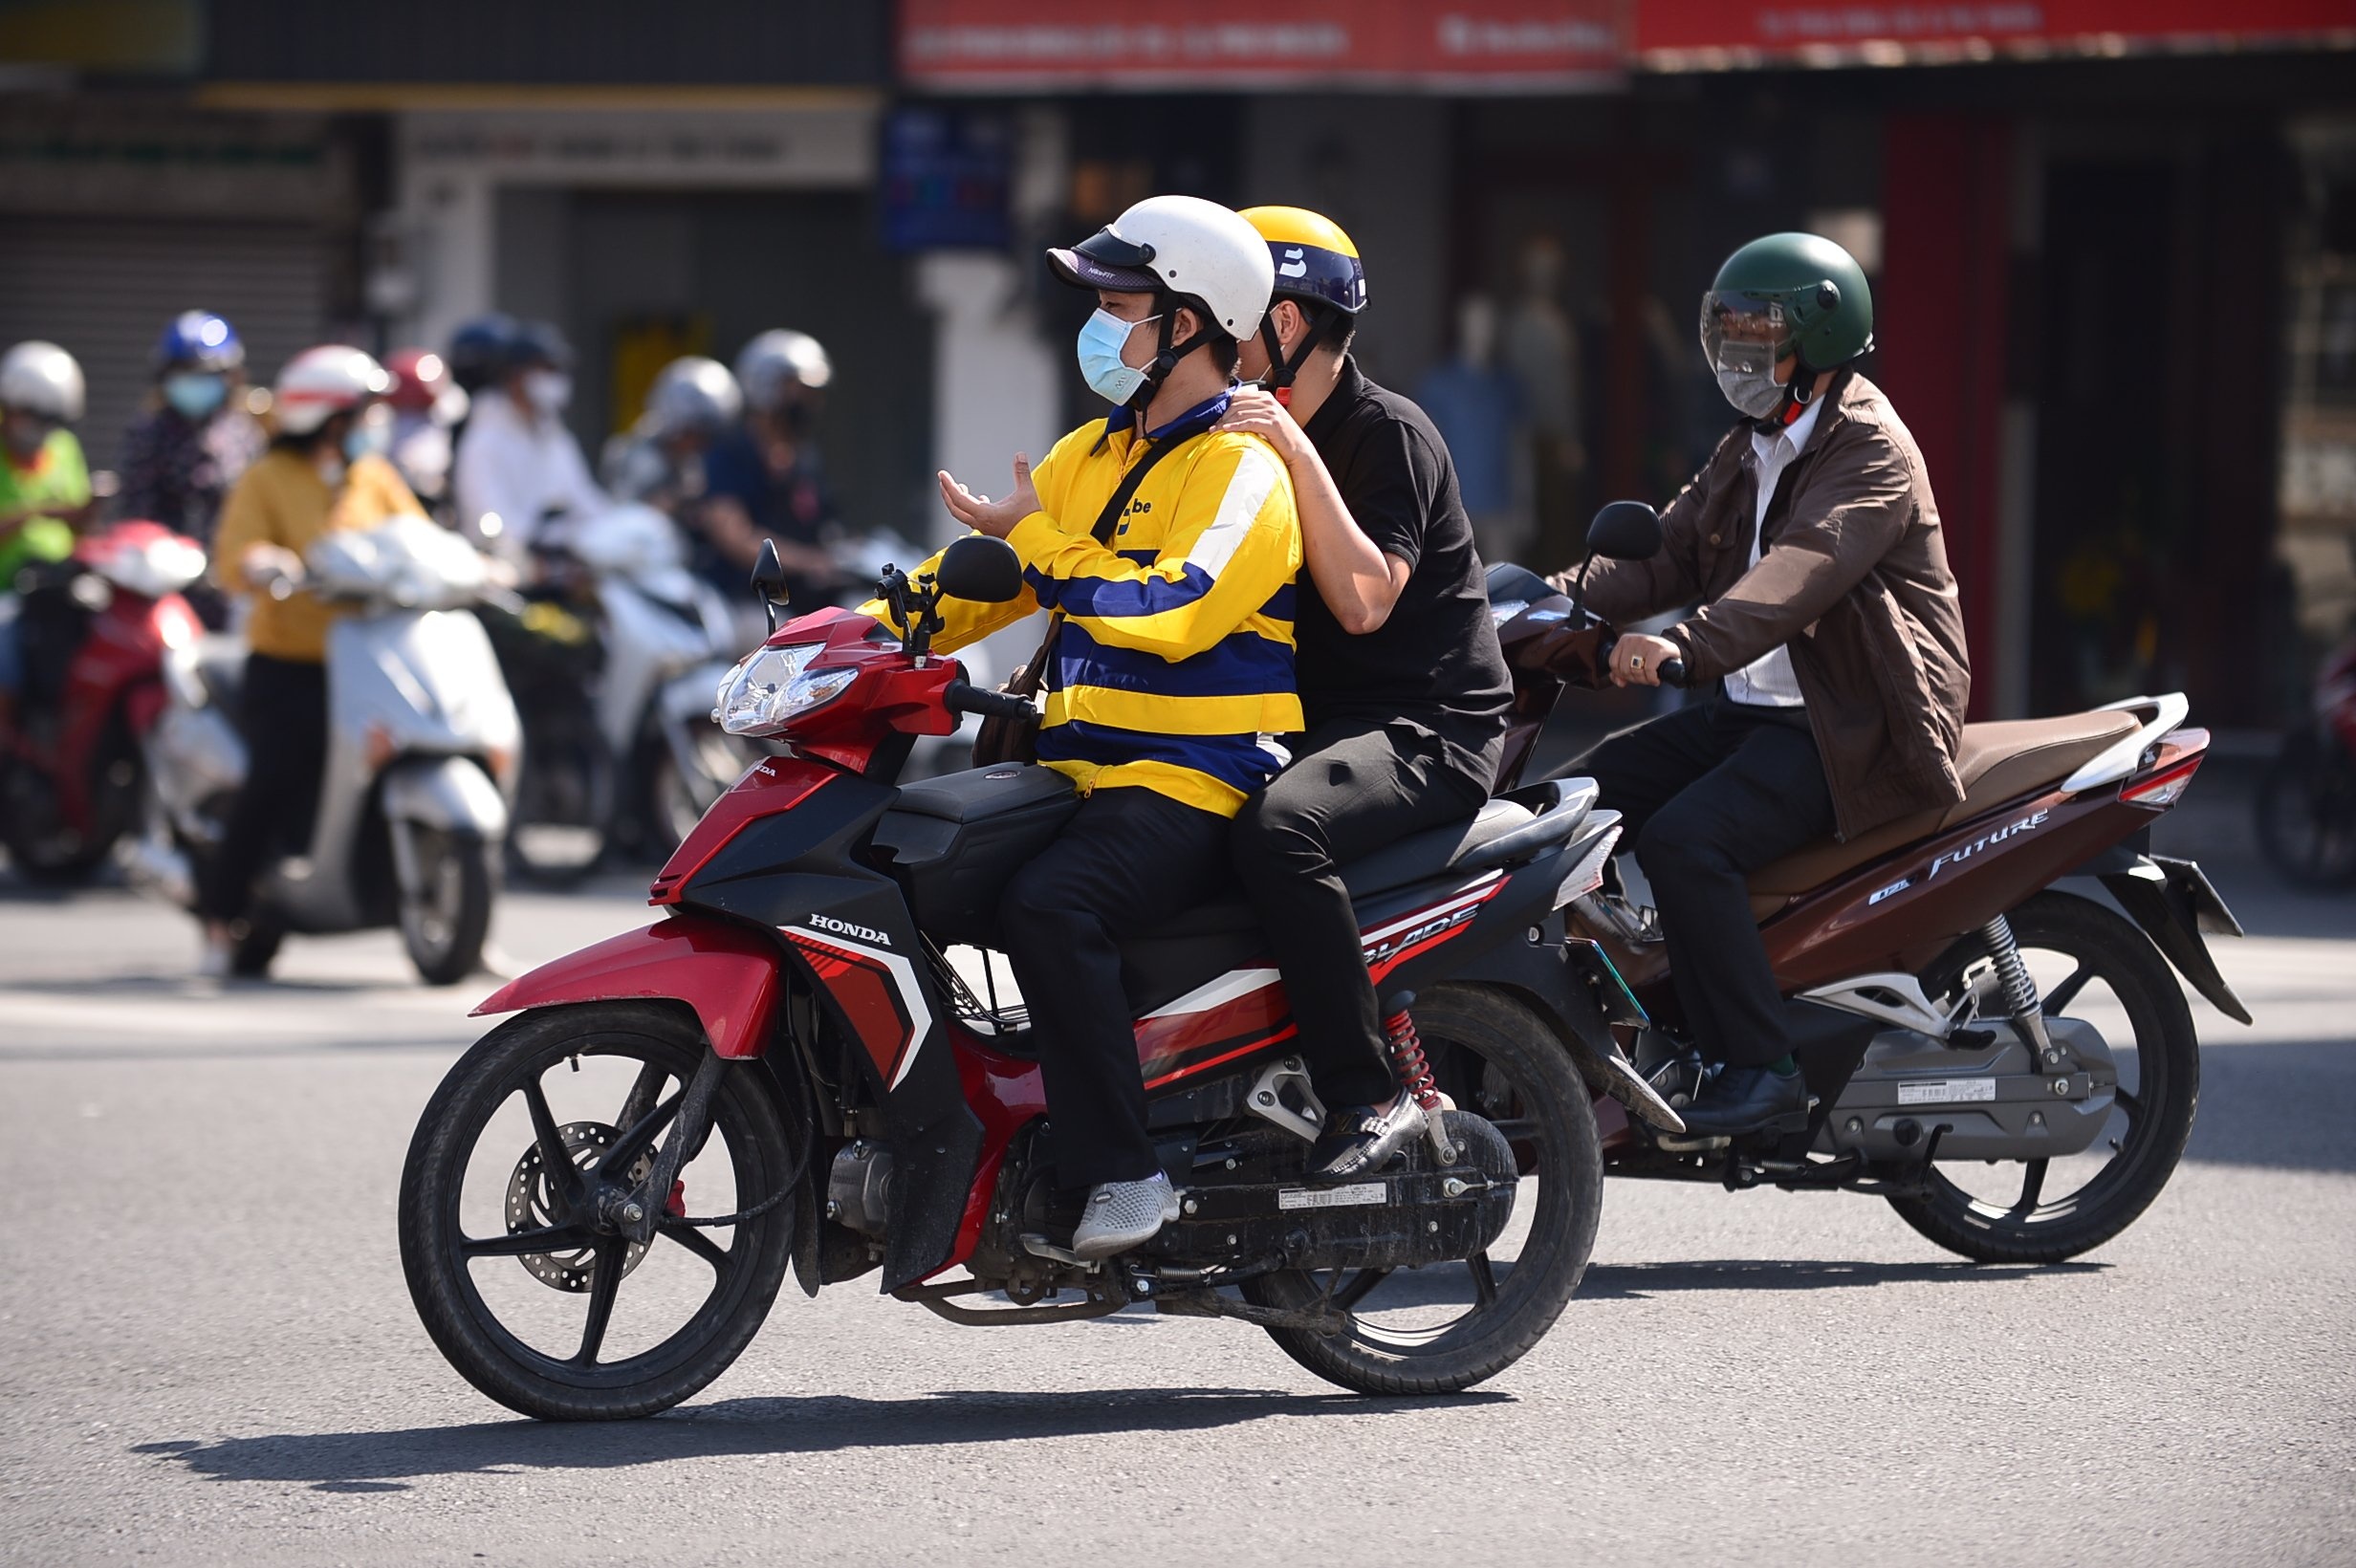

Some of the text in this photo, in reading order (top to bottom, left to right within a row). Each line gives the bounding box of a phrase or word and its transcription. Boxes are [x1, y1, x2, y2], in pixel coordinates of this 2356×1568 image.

[1132, 498, 1151, 513] be
[754, 765, 776, 776] NDA
[1929, 808, 2050, 881] FUTURE
[809, 913, 892, 947] HONDA
